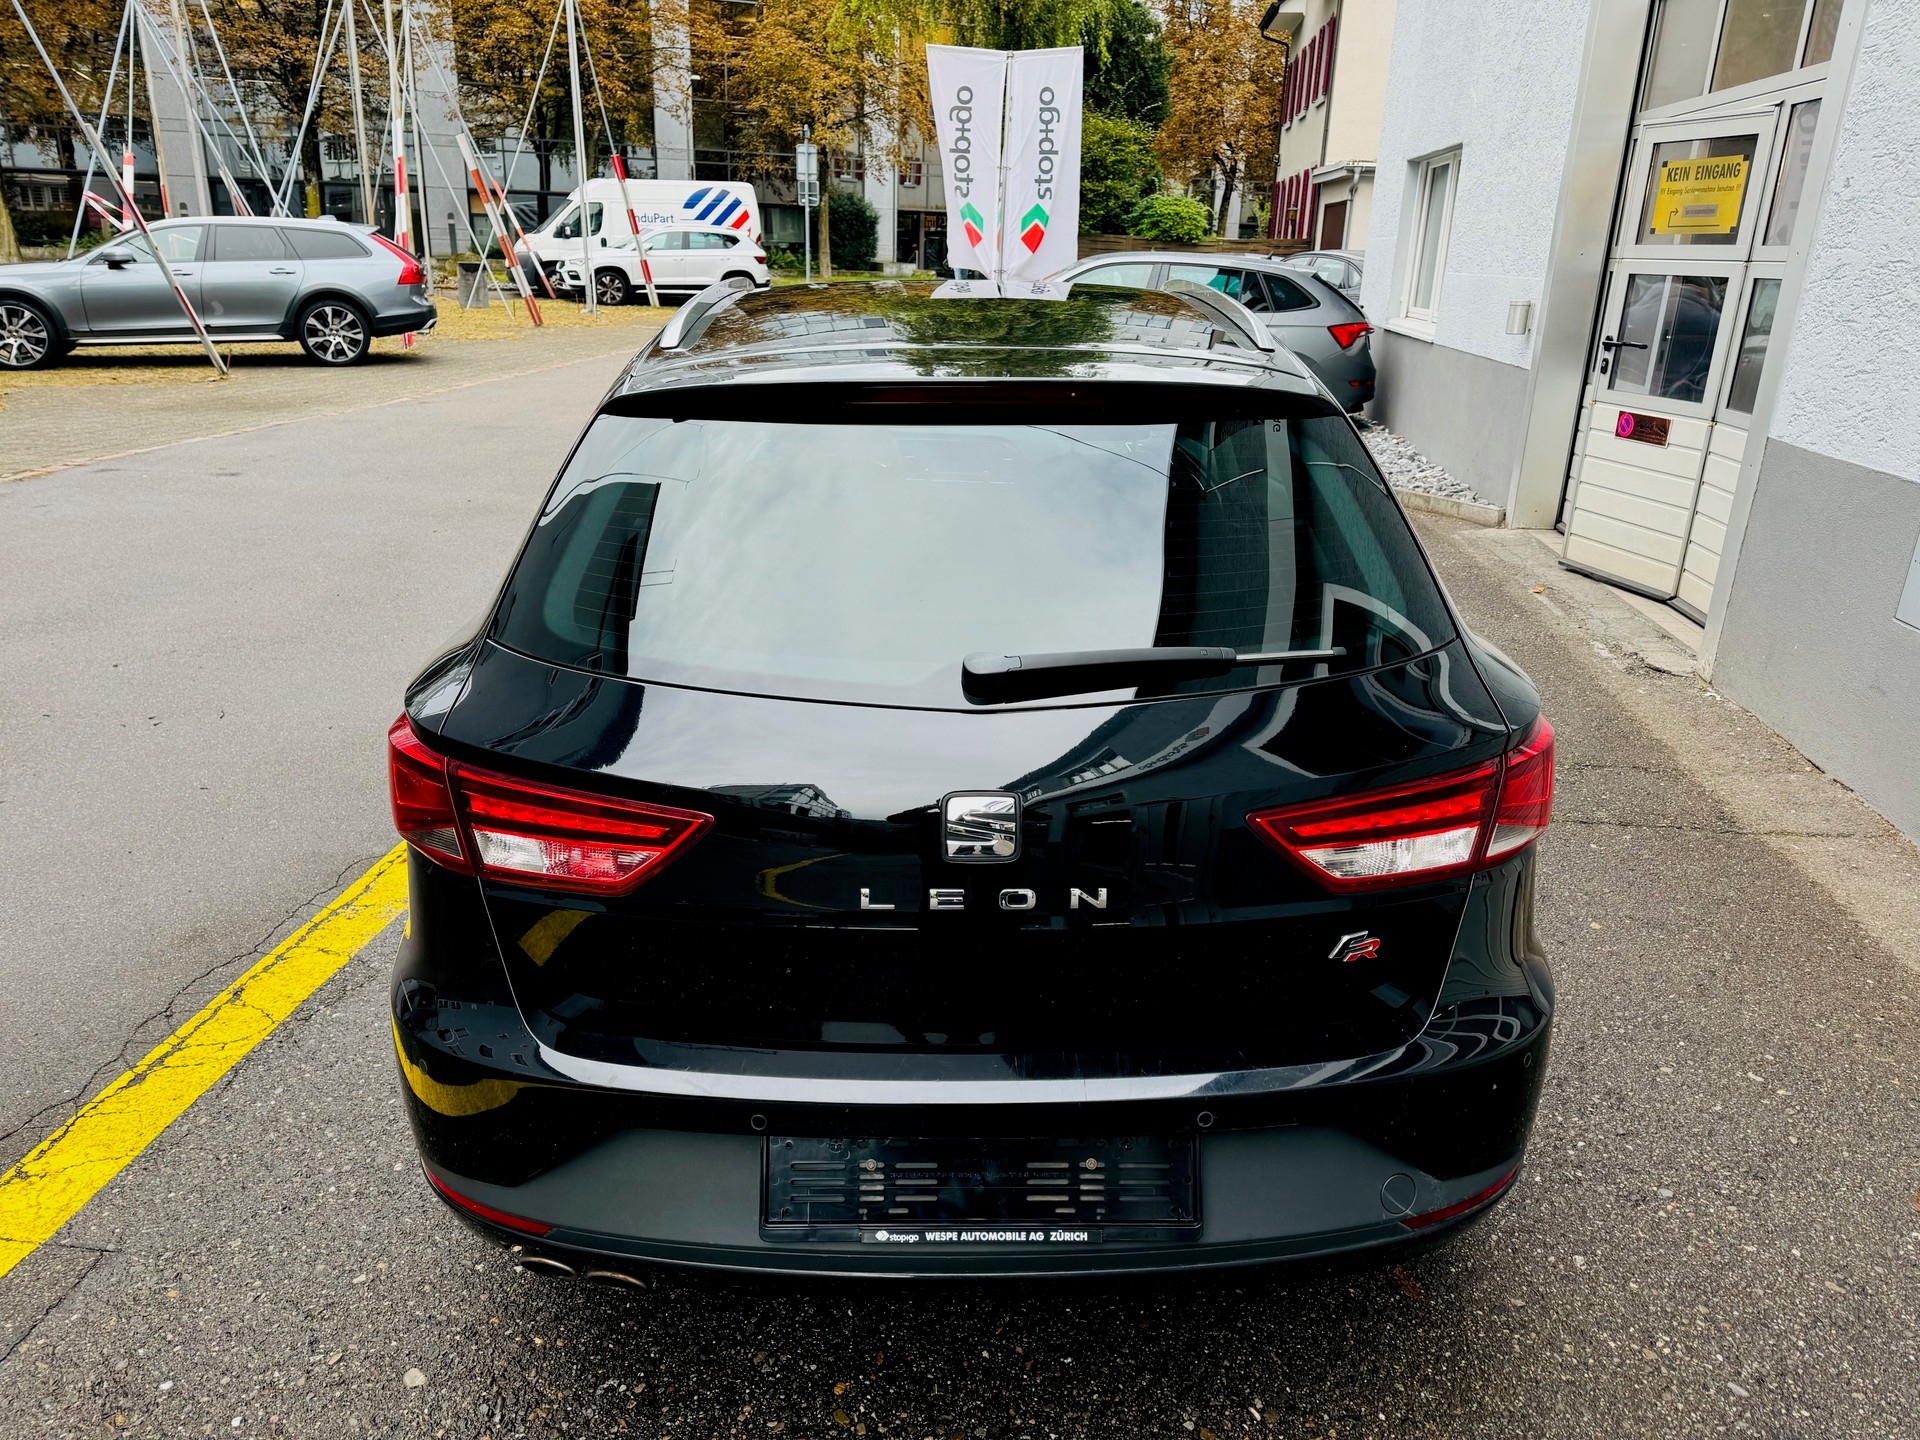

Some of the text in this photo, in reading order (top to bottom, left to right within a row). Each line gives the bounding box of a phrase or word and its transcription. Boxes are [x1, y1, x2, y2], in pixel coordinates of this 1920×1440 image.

[1666, 162, 1742, 182] KEIN EINGANG
[1667, 187, 1683, 196] Eingang
[635, 212, 675, 223] nduPart
[860, 887, 1107, 910] LEON
[1328, 930, 1380, 962] FR
[925, 1231, 958, 1241] WESPE
[960, 1231, 1026, 1241] AUTOMOBILE
[1029, 1231, 1045, 1241] AG
[1049, 1230, 1088, 1241] ZÜRICH
